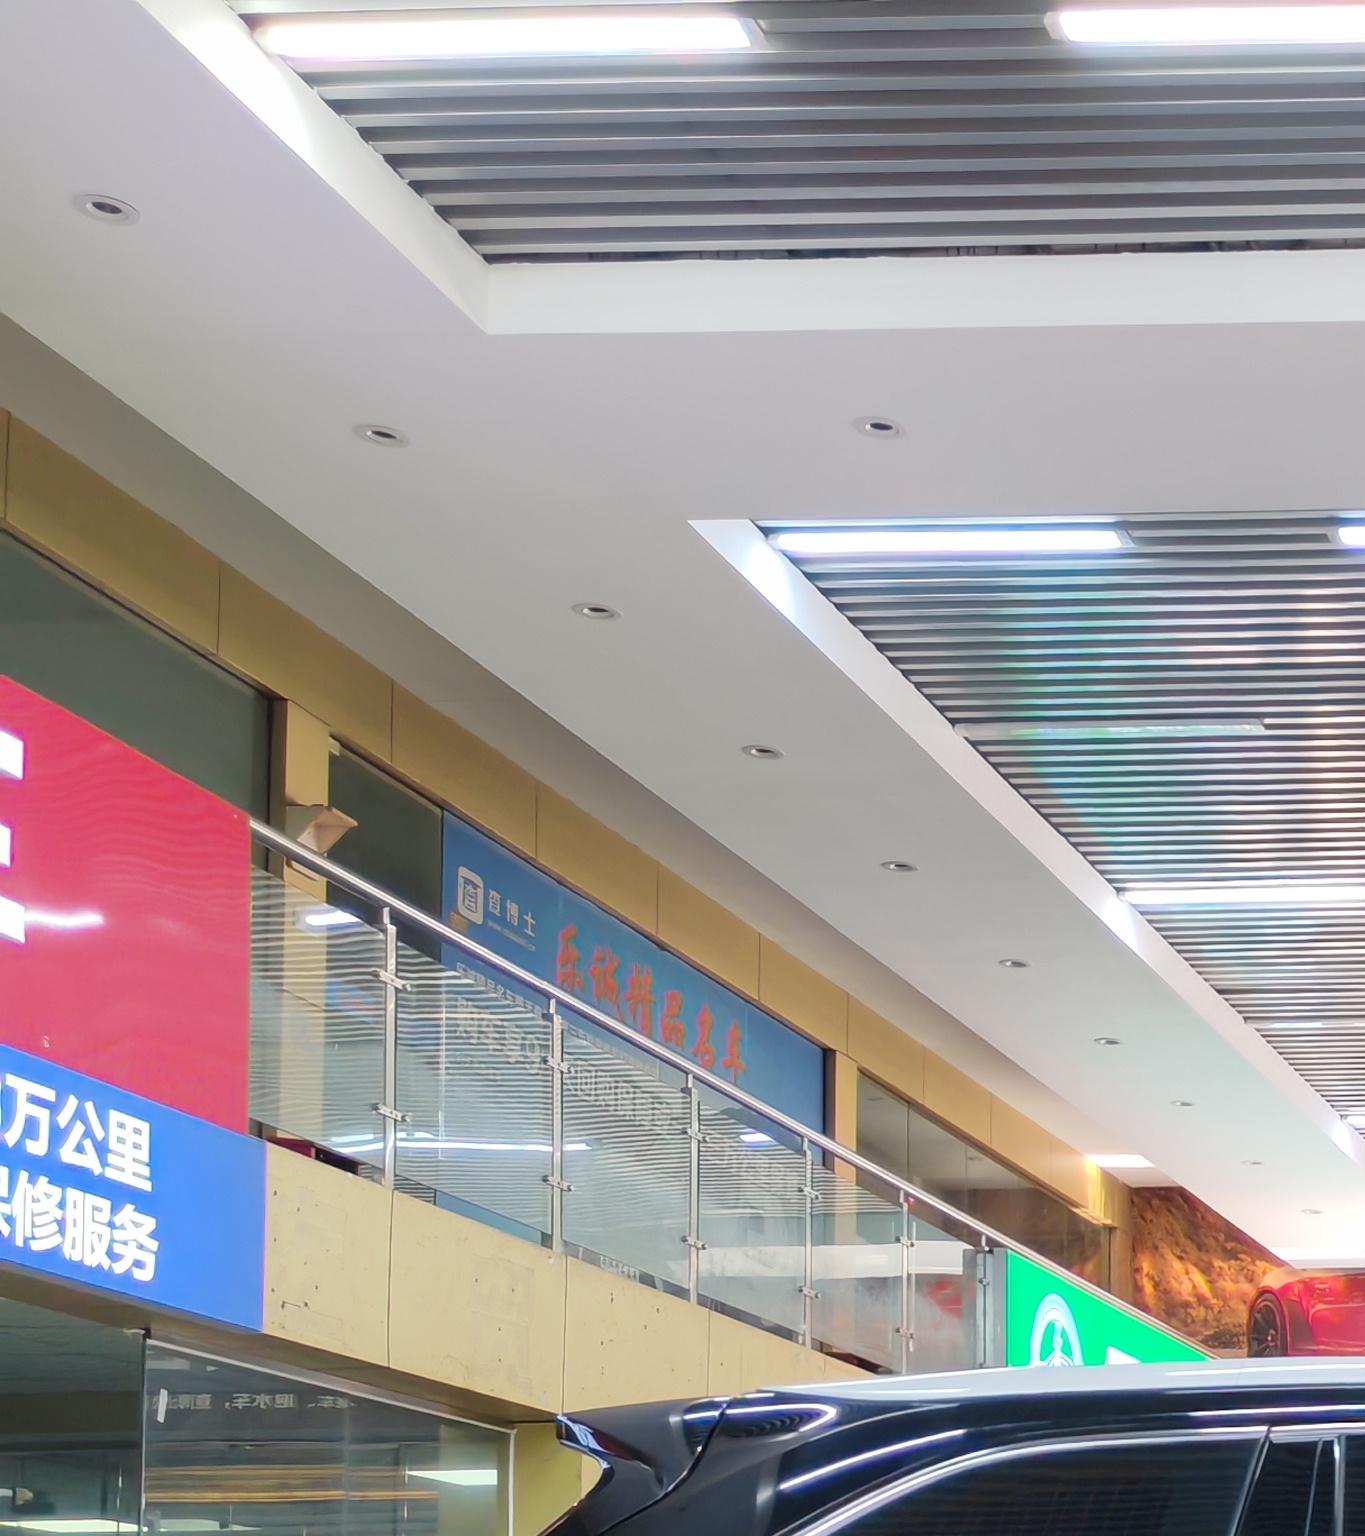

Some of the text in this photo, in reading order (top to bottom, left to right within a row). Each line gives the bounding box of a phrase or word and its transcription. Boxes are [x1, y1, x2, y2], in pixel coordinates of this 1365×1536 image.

[489, 889, 536, 937] 查博士
[0, 1072, 153, 1193] 万公里
